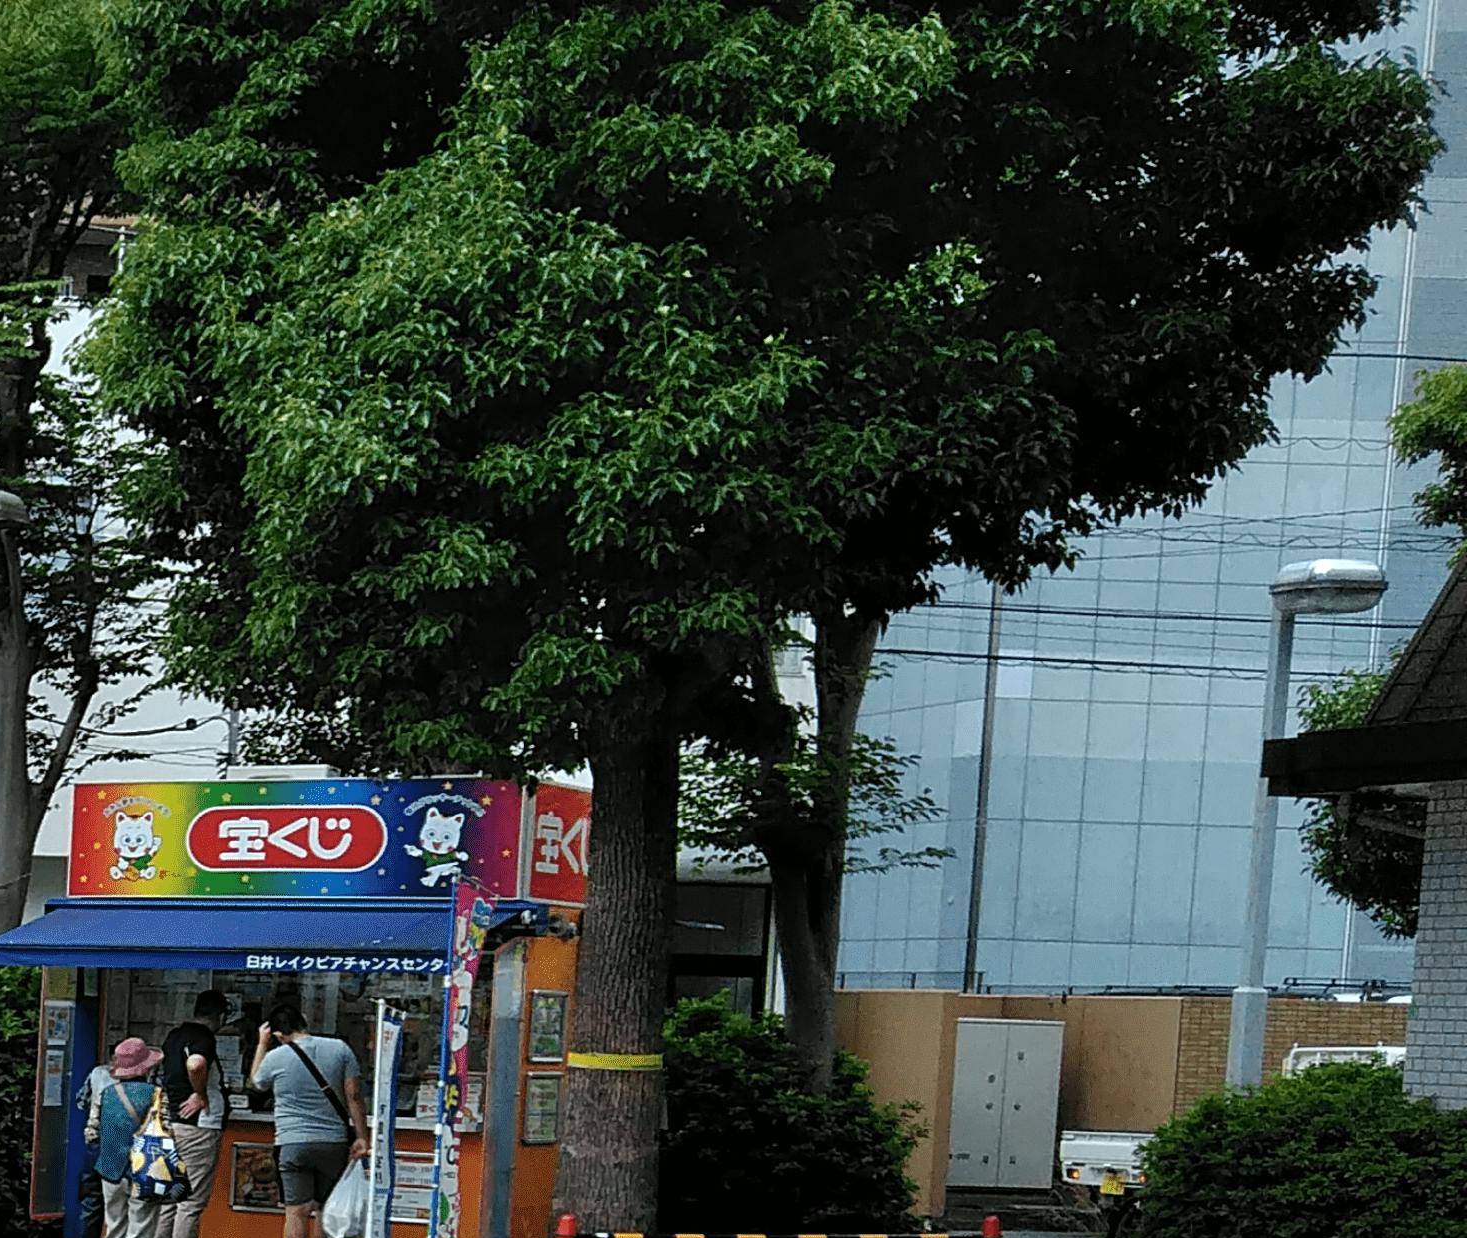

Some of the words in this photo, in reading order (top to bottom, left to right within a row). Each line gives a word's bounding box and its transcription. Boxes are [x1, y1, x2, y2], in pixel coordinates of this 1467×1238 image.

[219, 816, 353, 861] 宝くじ
[246, 954, 450, 972] 臼井レイクピアチャンスセンタ
